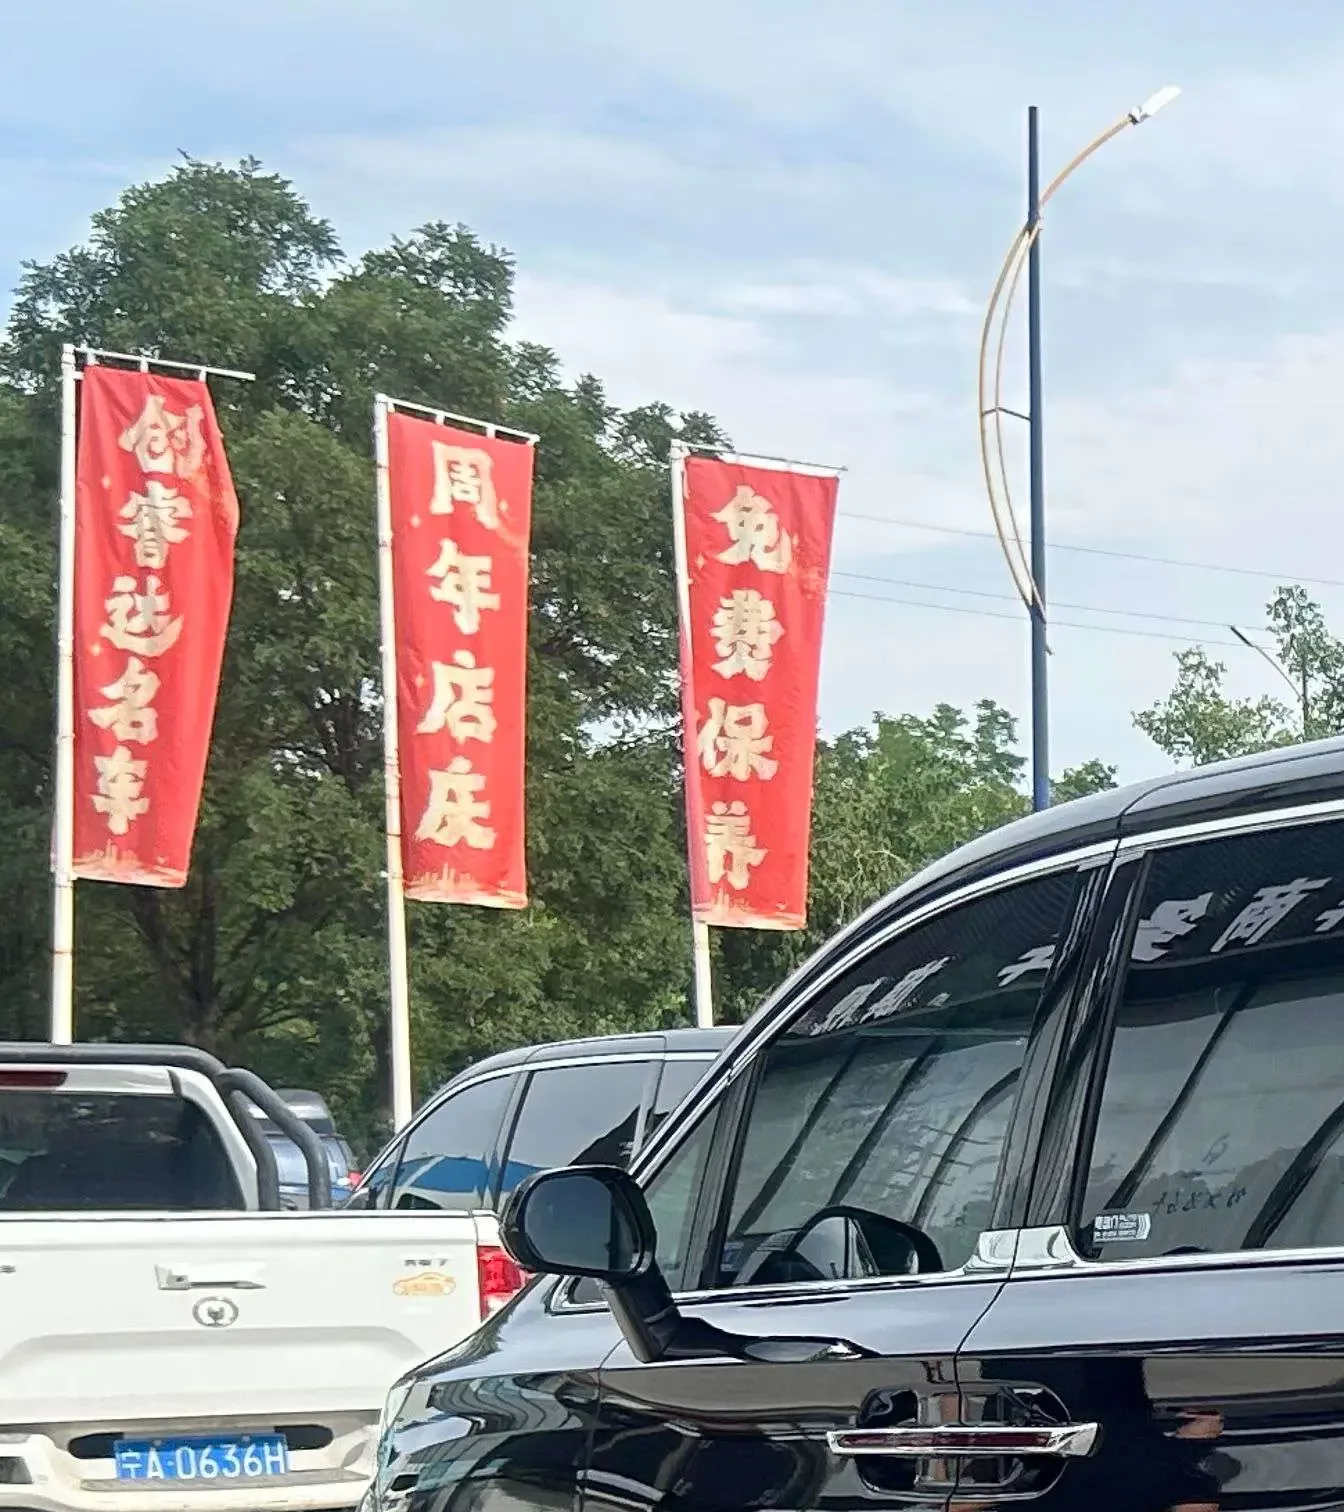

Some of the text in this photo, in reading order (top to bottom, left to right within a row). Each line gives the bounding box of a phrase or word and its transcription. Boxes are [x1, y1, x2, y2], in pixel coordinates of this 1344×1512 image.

[415, 438, 500, 851] 周年店庆
[697, 484, 793, 891] 免费保养
[121, 1442, 286, 1480] 宁A·0636H
